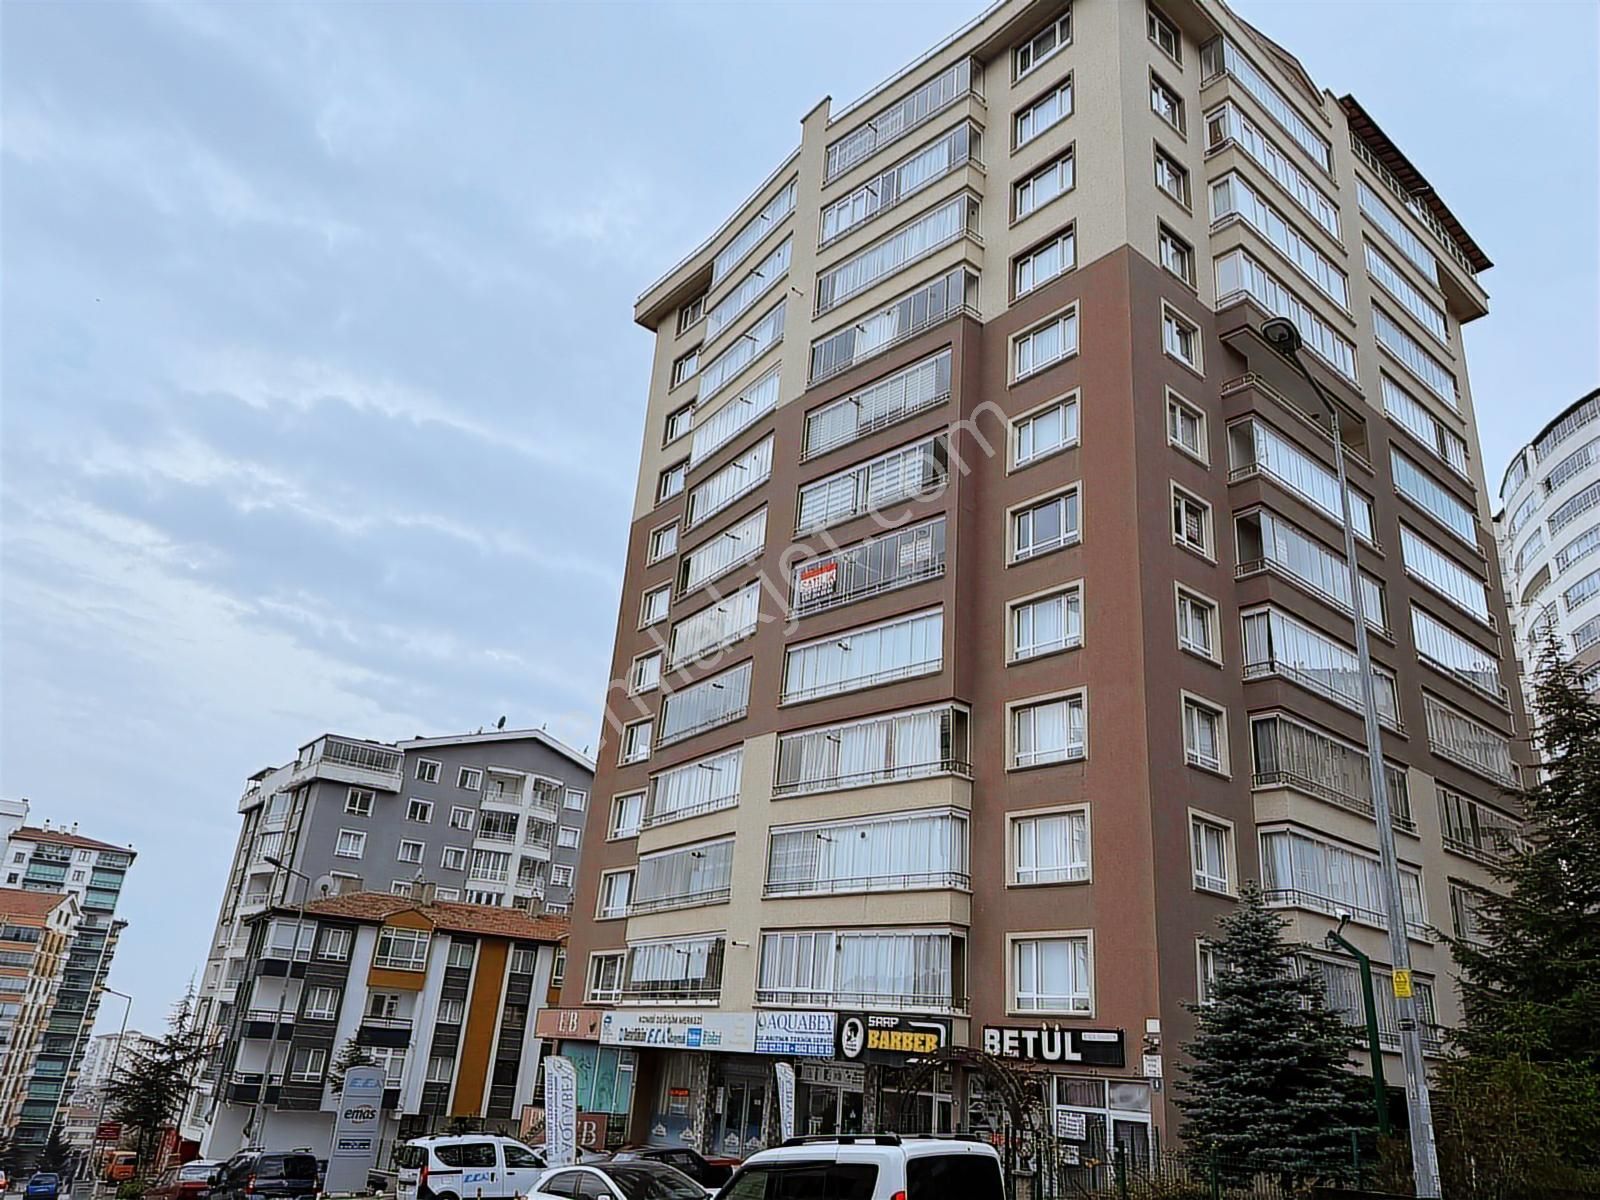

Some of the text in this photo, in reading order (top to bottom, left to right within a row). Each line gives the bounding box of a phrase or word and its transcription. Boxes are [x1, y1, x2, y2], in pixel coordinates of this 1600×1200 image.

[767, 1012, 833, 1032] AQUABEY
[867, 1029, 938, 1053] BARBER
[984, 1021, 1082, 1061] BETÜL
[344, 1108, 377, 1120] emas
